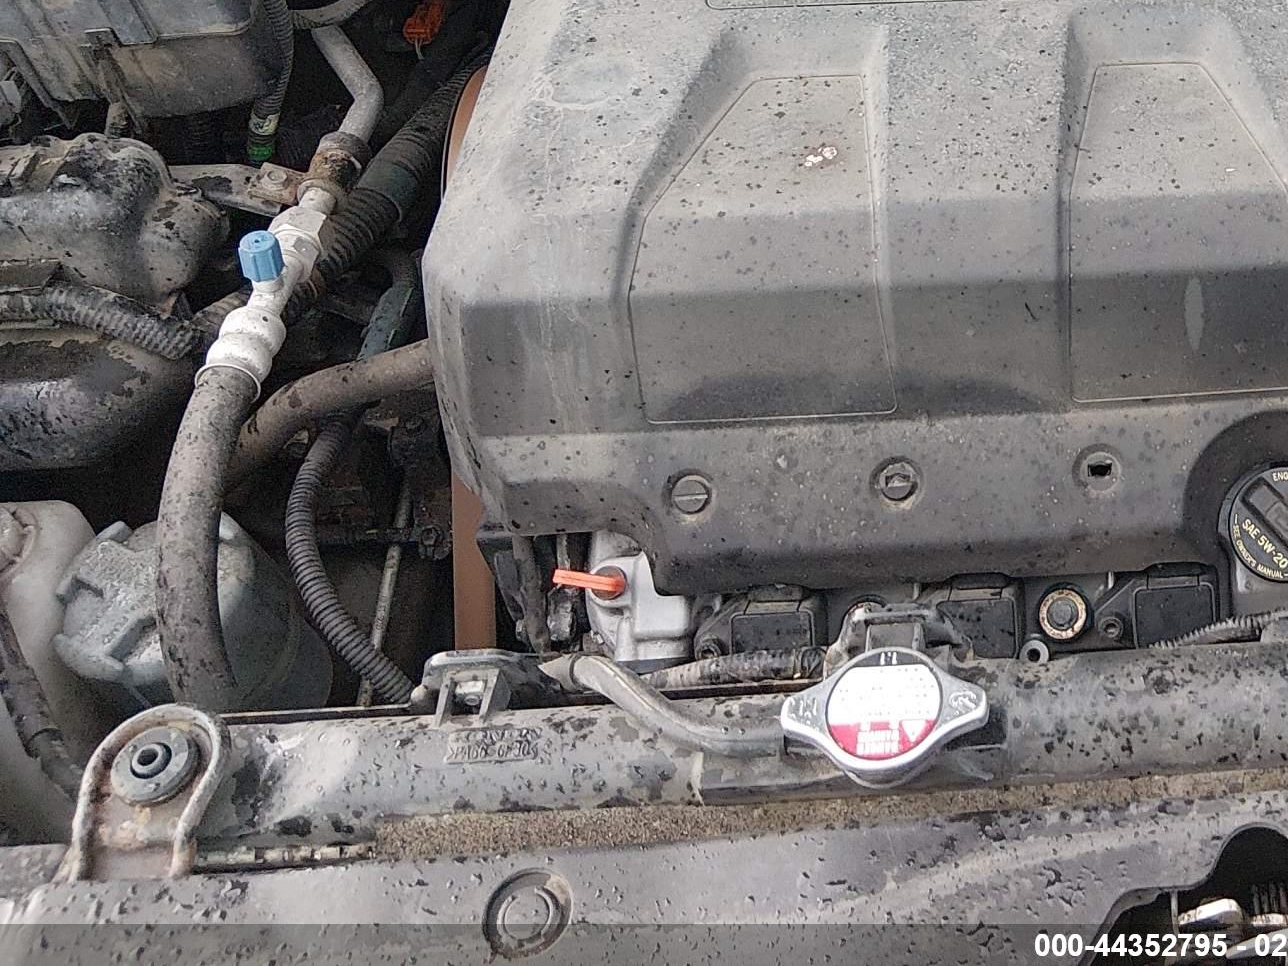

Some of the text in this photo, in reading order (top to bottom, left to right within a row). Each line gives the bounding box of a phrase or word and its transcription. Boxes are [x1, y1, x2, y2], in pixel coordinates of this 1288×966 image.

[1232, 524, 1241, 539] SEE
[1256, 564, 1284, 578] MANUAL
[1241, 518, 1288, 569] SAE 5W-20
